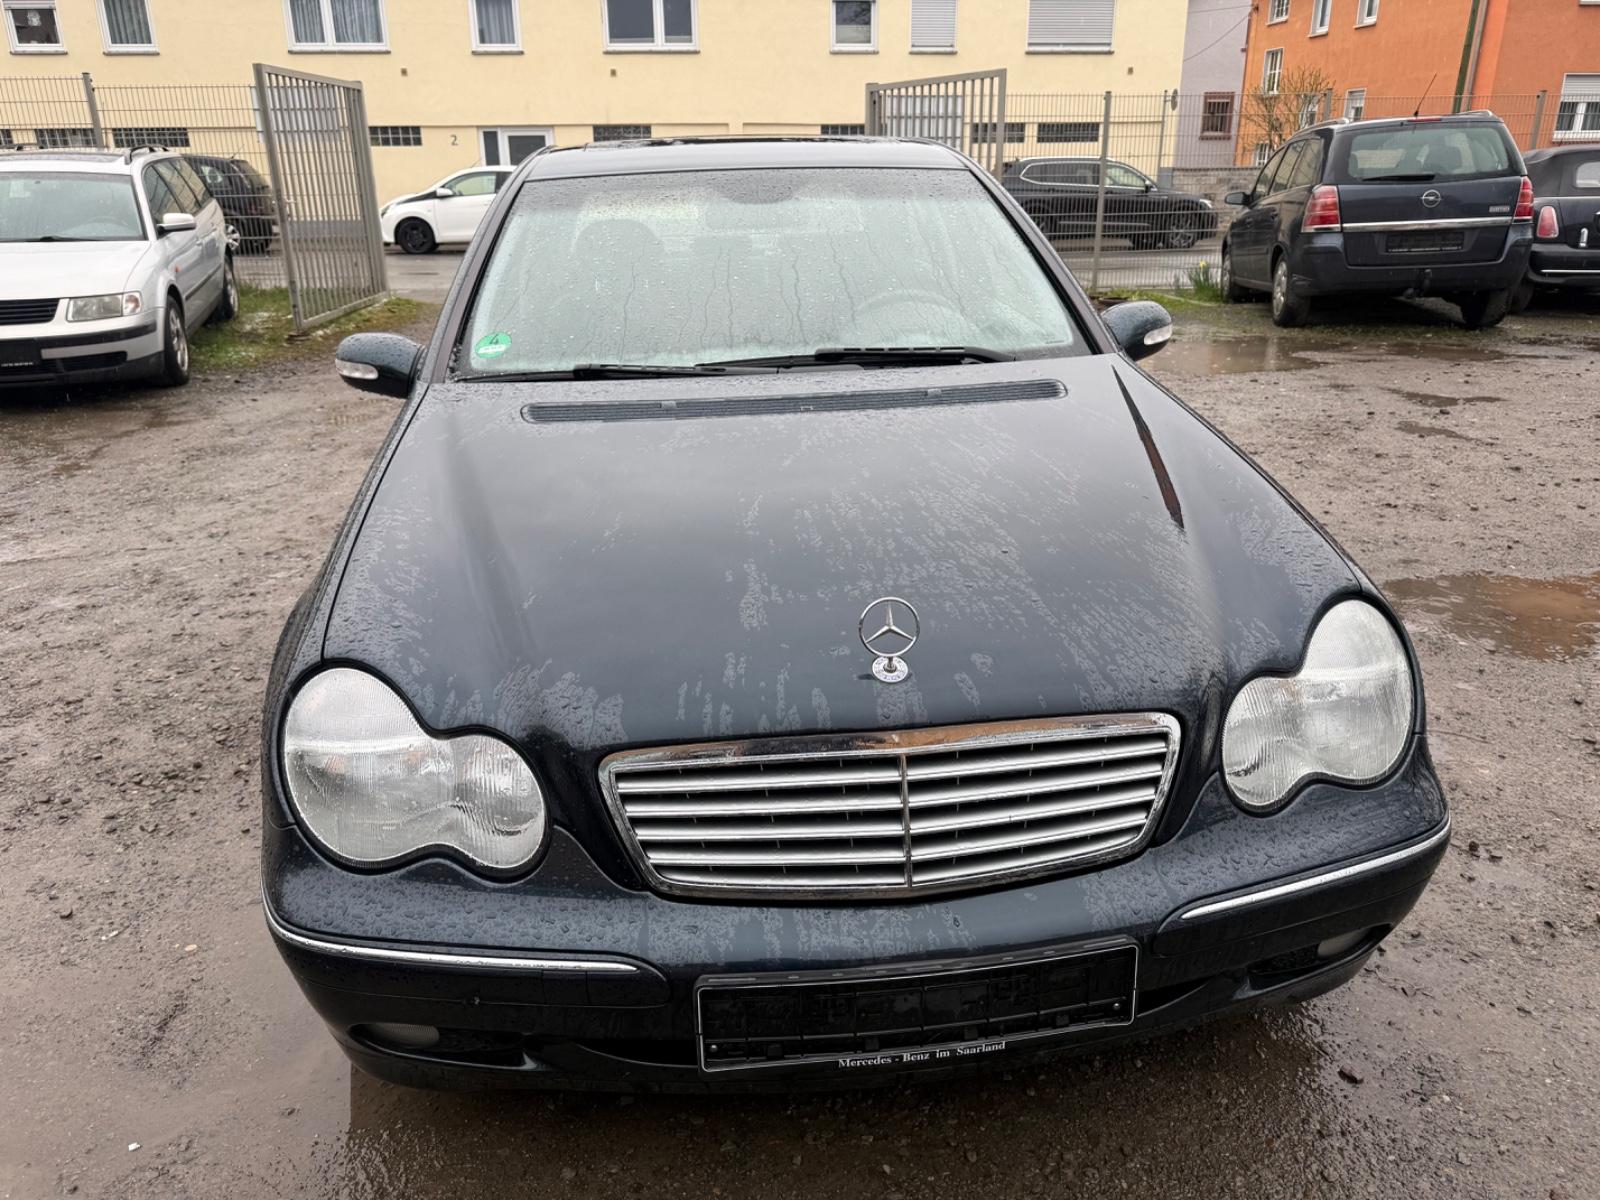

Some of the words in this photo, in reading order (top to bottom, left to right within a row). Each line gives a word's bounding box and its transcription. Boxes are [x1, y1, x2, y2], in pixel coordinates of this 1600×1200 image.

[450, 134, 458, 146] 2
[489, 333, 499, 345] 4
[838, 1056, 892, 1068] Mercedes
[902, 1052, 930, 1062] Benz
[936, 1049, 950, 1059] im
[956, 1041, 1006, 1056] Saarland
